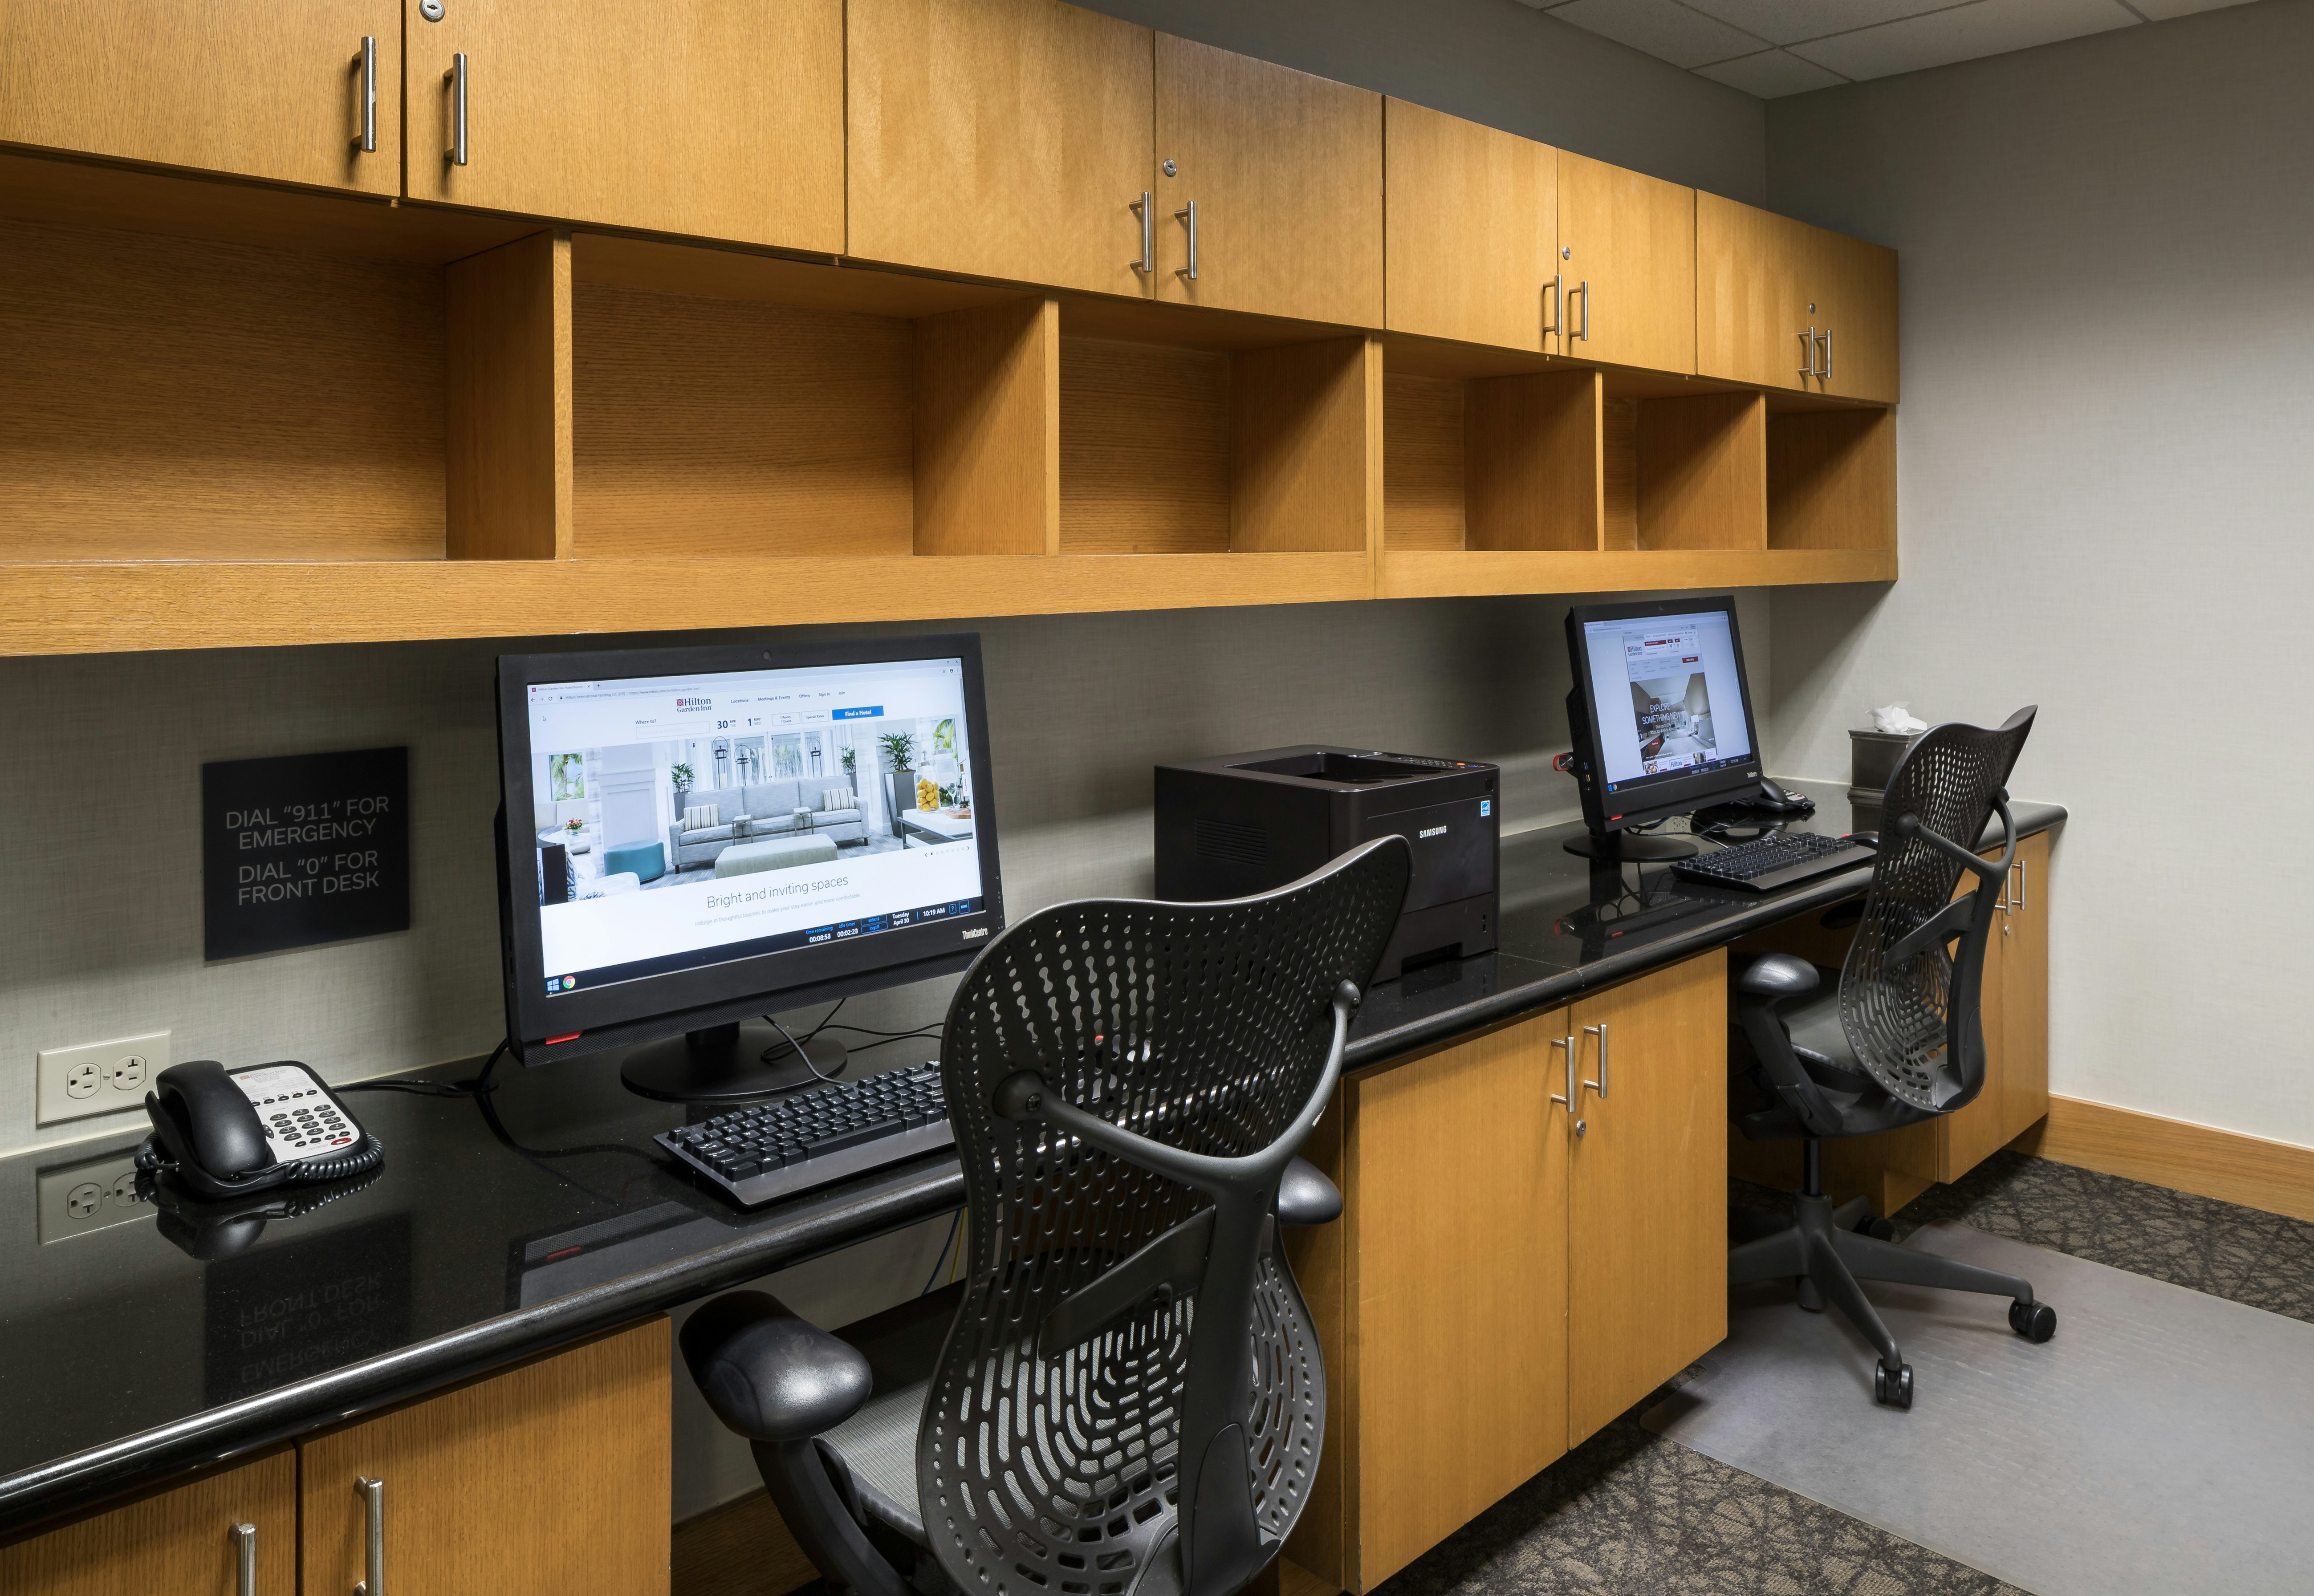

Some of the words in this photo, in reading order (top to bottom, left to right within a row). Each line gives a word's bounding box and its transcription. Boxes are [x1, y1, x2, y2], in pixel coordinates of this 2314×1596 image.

[684, 698, 711, 706] Hilton
[1650, 703, 1671, 713] EXPLORE
[717, 720, 728, 729] 30
[748, 718, 752, 726] 1
[1642, 713, 1670, 724] SOMETHING
[226, 808, 278, 829] DIAL
[346, 796, 389, 816] FOR
[240, 818, 377, 849] EMERGENCY
[1419, 825, 1447, 839] SAMSUNG
[239, 861, 292, 883] DIAL
[335, 850, 378, 871] FOR
[239, 879, 317, 906] FRONT
[323, 871, 379, 894] DESK
[707, 892, 742, 908] Bright
[745, 888, 766, 902] and
[769, 882, 808, 898] inviting
[812, 876, 848, 892] spaces
[962, 927, 988, 940] ThinkCentre
